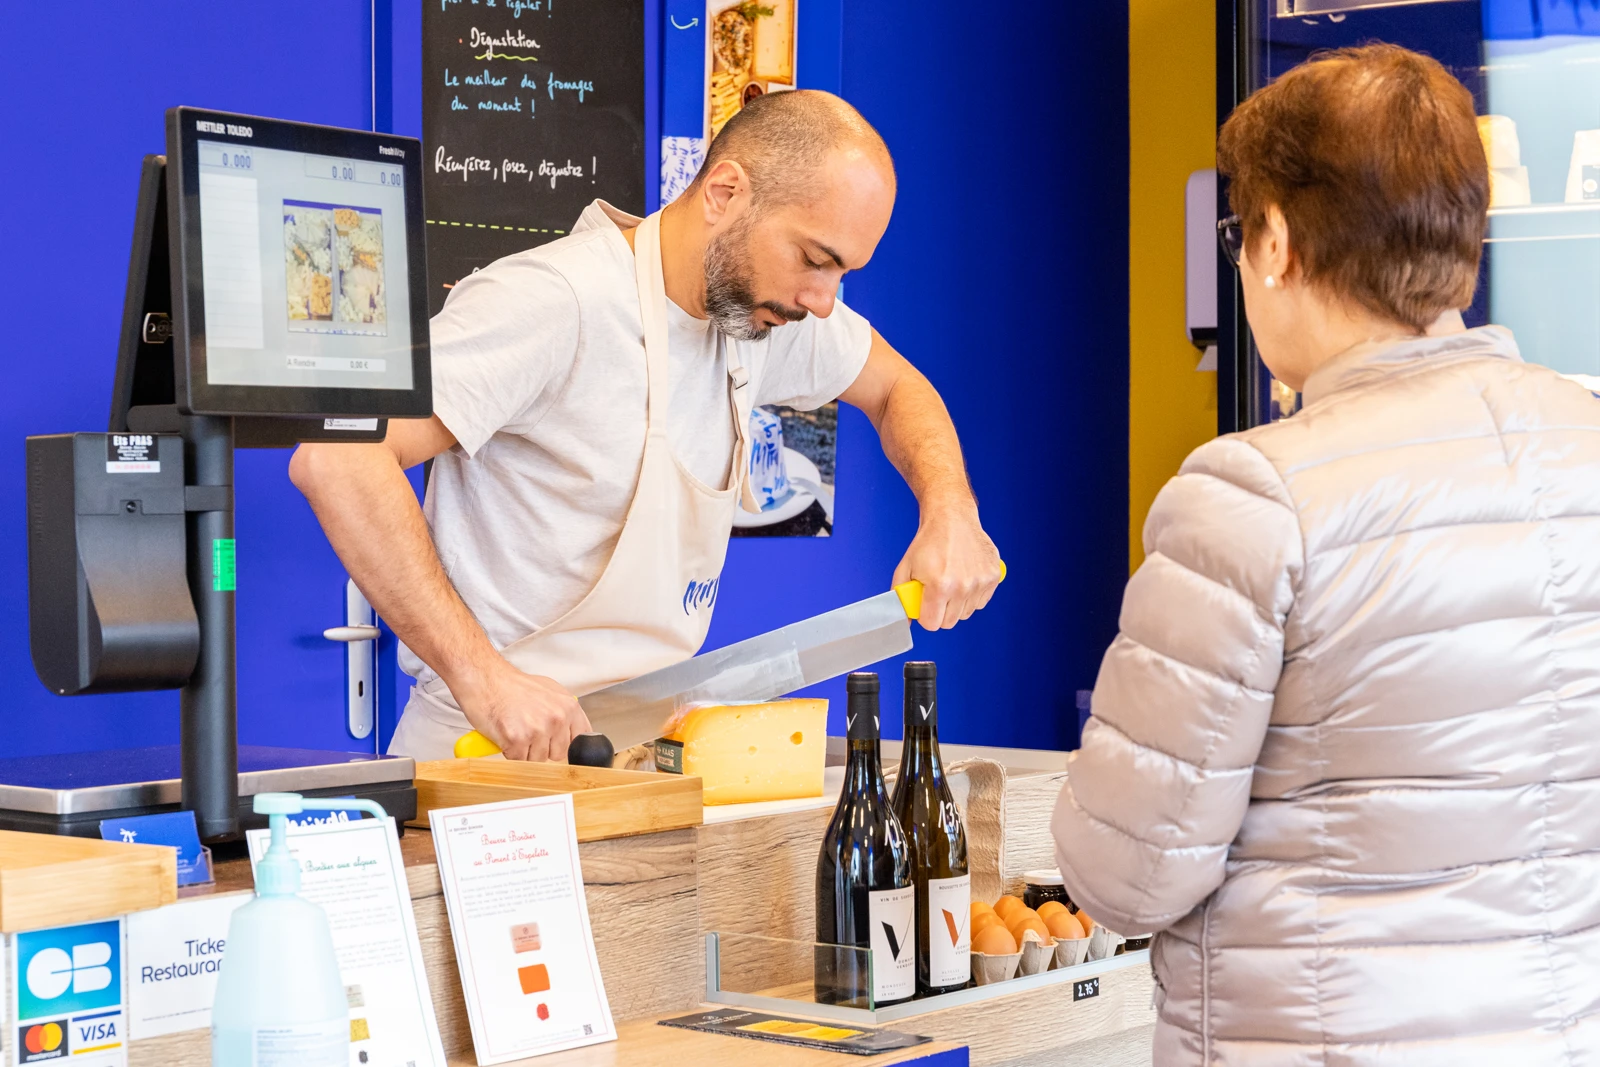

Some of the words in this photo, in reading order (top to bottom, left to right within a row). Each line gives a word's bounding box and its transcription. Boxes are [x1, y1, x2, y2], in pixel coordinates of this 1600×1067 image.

[470, 27, 541, 60] Dégustation
[445, 69, 460, 87] Le
[465, 69, 508, 87] meilleur
[521, 74, 537, 90] des
[547, 72, 594, 103] fromages
[451, 96, 469, 111] du
[478, 97, 522, 112] moment
[196, 121, 225, 135] METTLER
[227, 124, 253, 138] TOLEDO
[222, 152, 251, 168] 0.000
[332, 165, 353, 181] 0.00
[380, 172, 401, 186] 0.00
[481, 833, 507, 846] Beurre
[509, 830, 536, 842] Bordier
[353, 856, 377, 871] algues
[485, 852, 510, 866] Piment
[512, 848, 550, 864] d'Espelette
[184, 938, 226, 957] Ticke
[79, 1022, 116, 1042] VISA
[26, 1049, 62, 1062] mastercard
